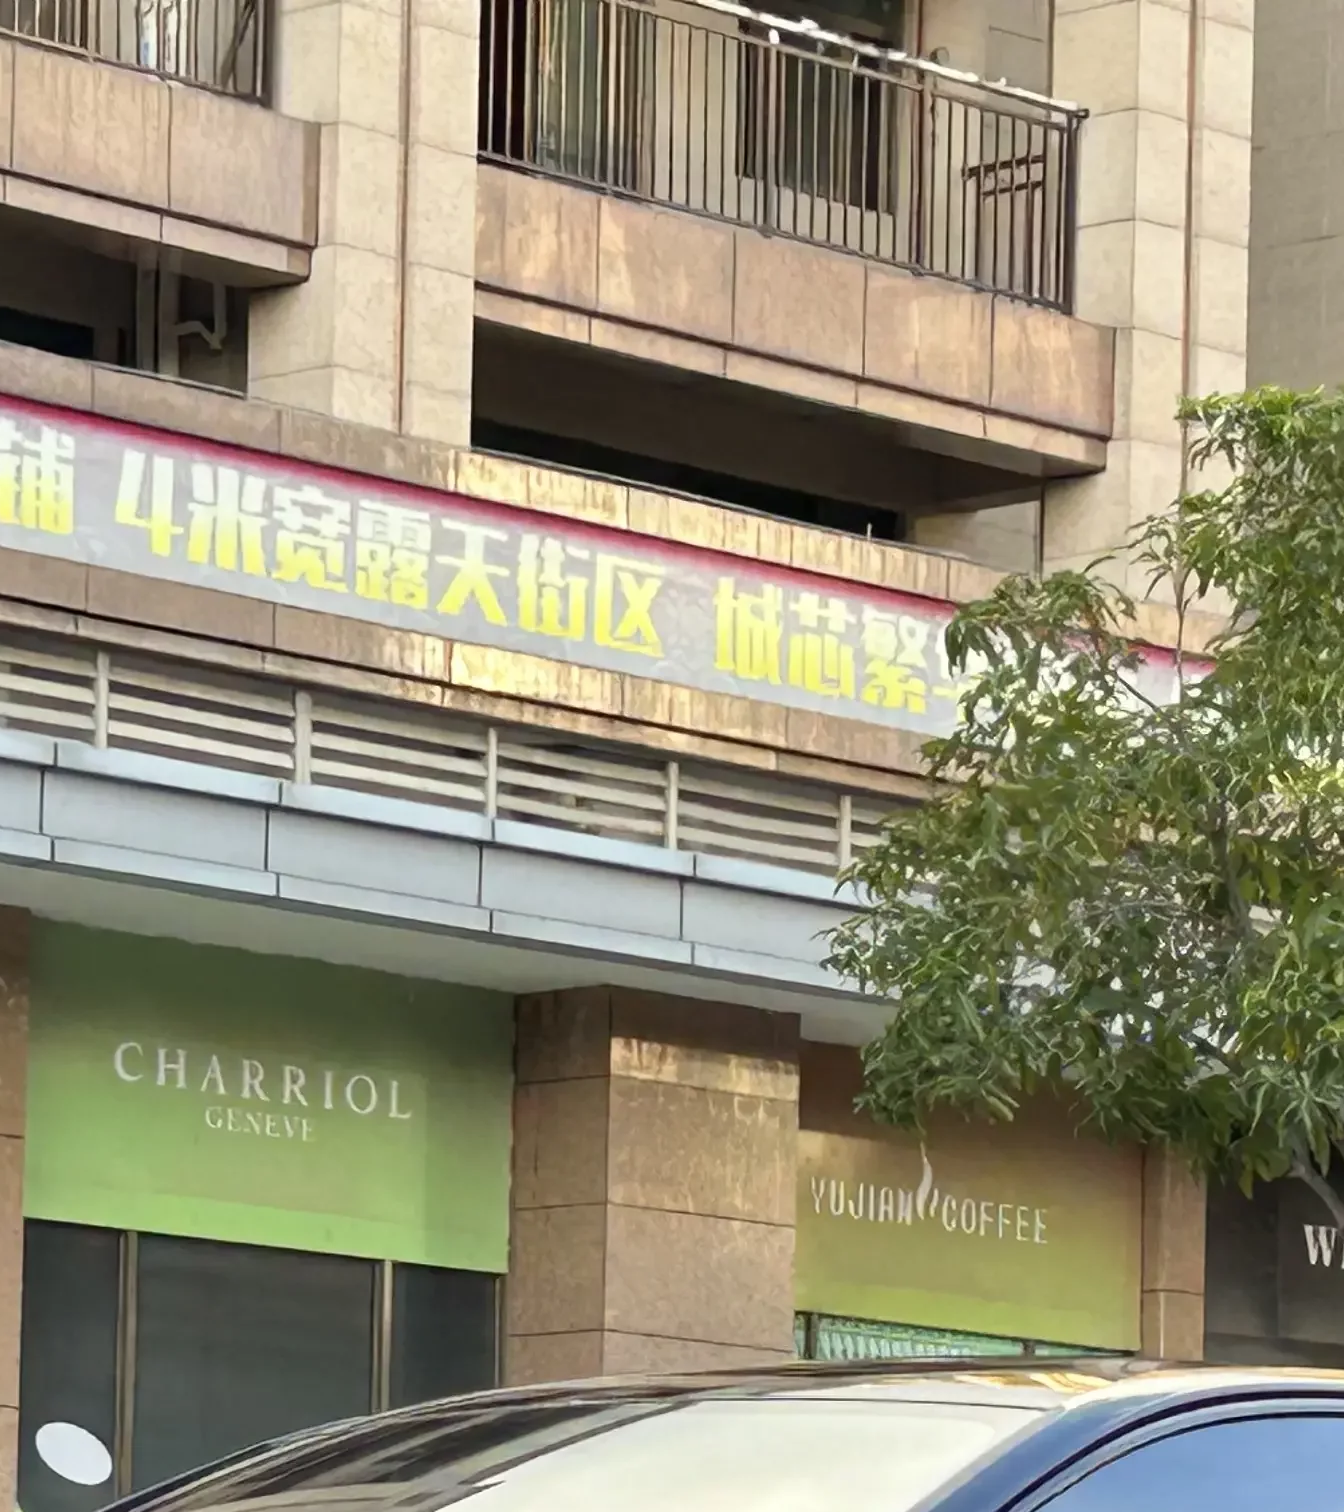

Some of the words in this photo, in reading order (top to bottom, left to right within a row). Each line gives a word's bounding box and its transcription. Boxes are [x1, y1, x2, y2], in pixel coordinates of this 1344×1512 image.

[114, 450, 665, 658] 4米宽露天街区
[113, 1041, 413, 1119] CHARRIOL
[204, 1105, 316, 1142] GENEVE
[810, 1175, 913, 1226] YUJIAN
[941, 1194, 1049, 1245] COFFEE
